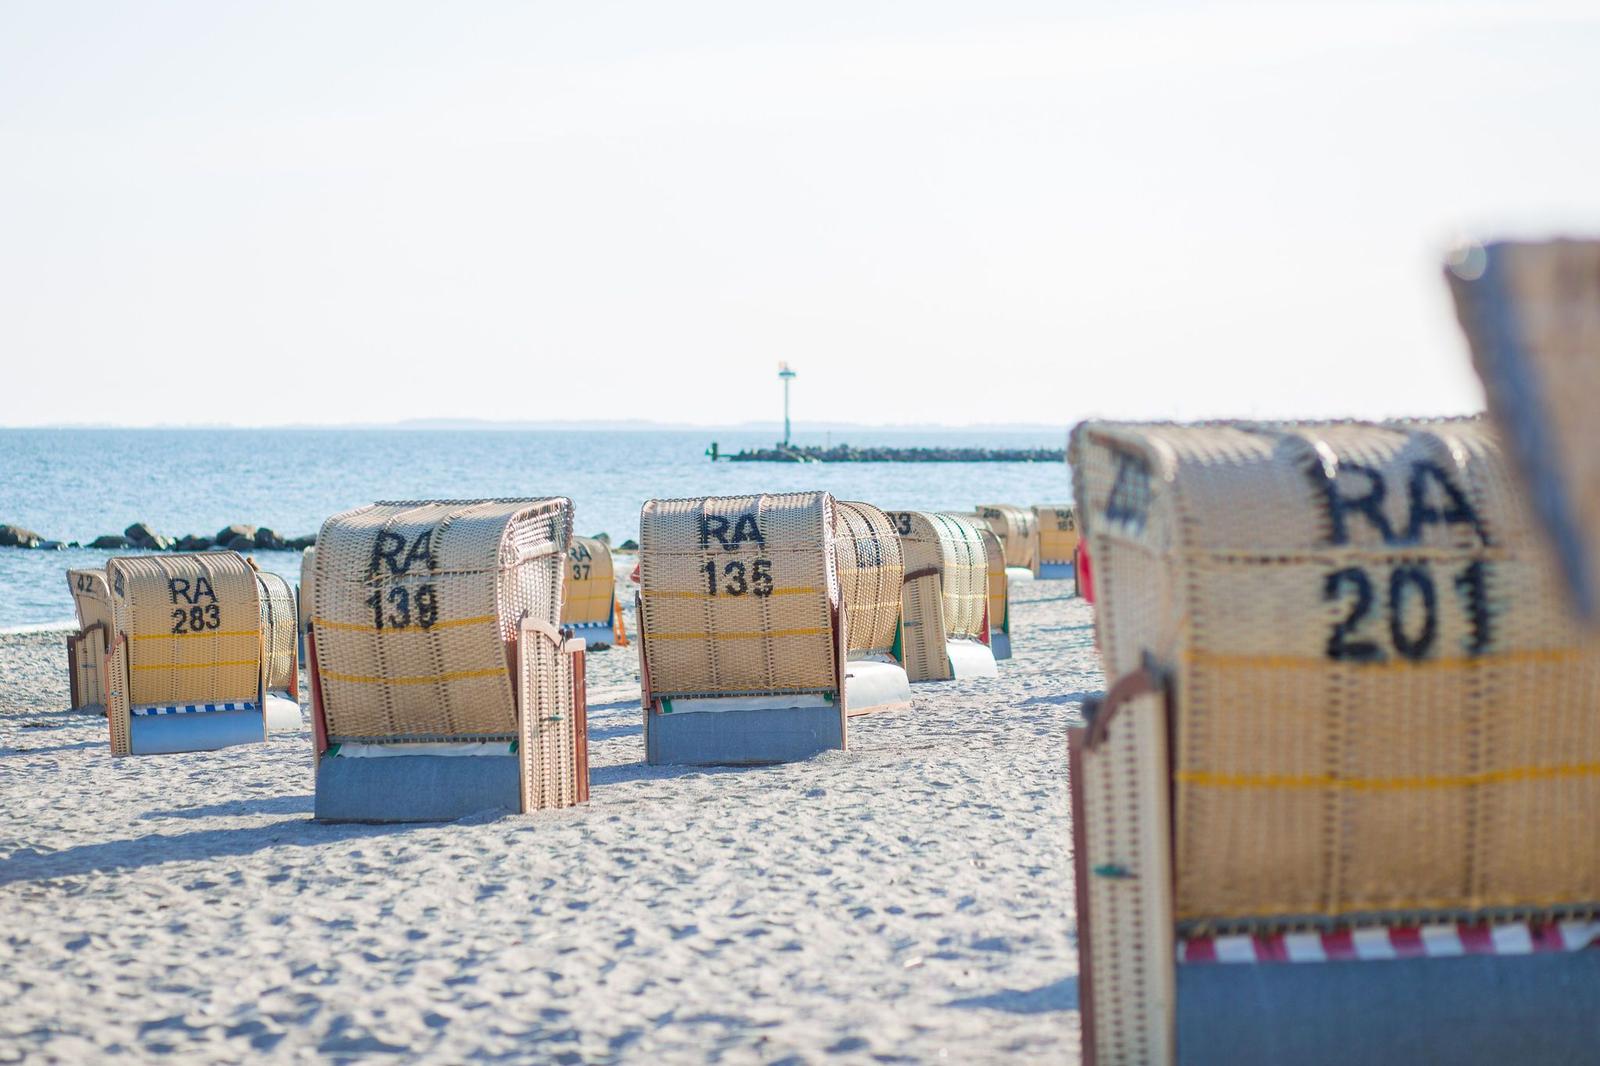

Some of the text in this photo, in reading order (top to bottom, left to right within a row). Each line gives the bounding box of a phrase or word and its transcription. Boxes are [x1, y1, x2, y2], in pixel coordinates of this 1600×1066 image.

[1312, 460, 1492, 548] RA
[700, 513, 765, 551] RA
[369, 528, 437, 576] RA
[77, 573, 94, 593] 42
[169, 576, 219, 605] RA
[573, 564, 590, 581] 37
[703, 558, 774, 597] 135
[171, 604, 221, 634] 283
[365, 584, 438, 630] 139
[1324, 560, 1494, 662] 201
